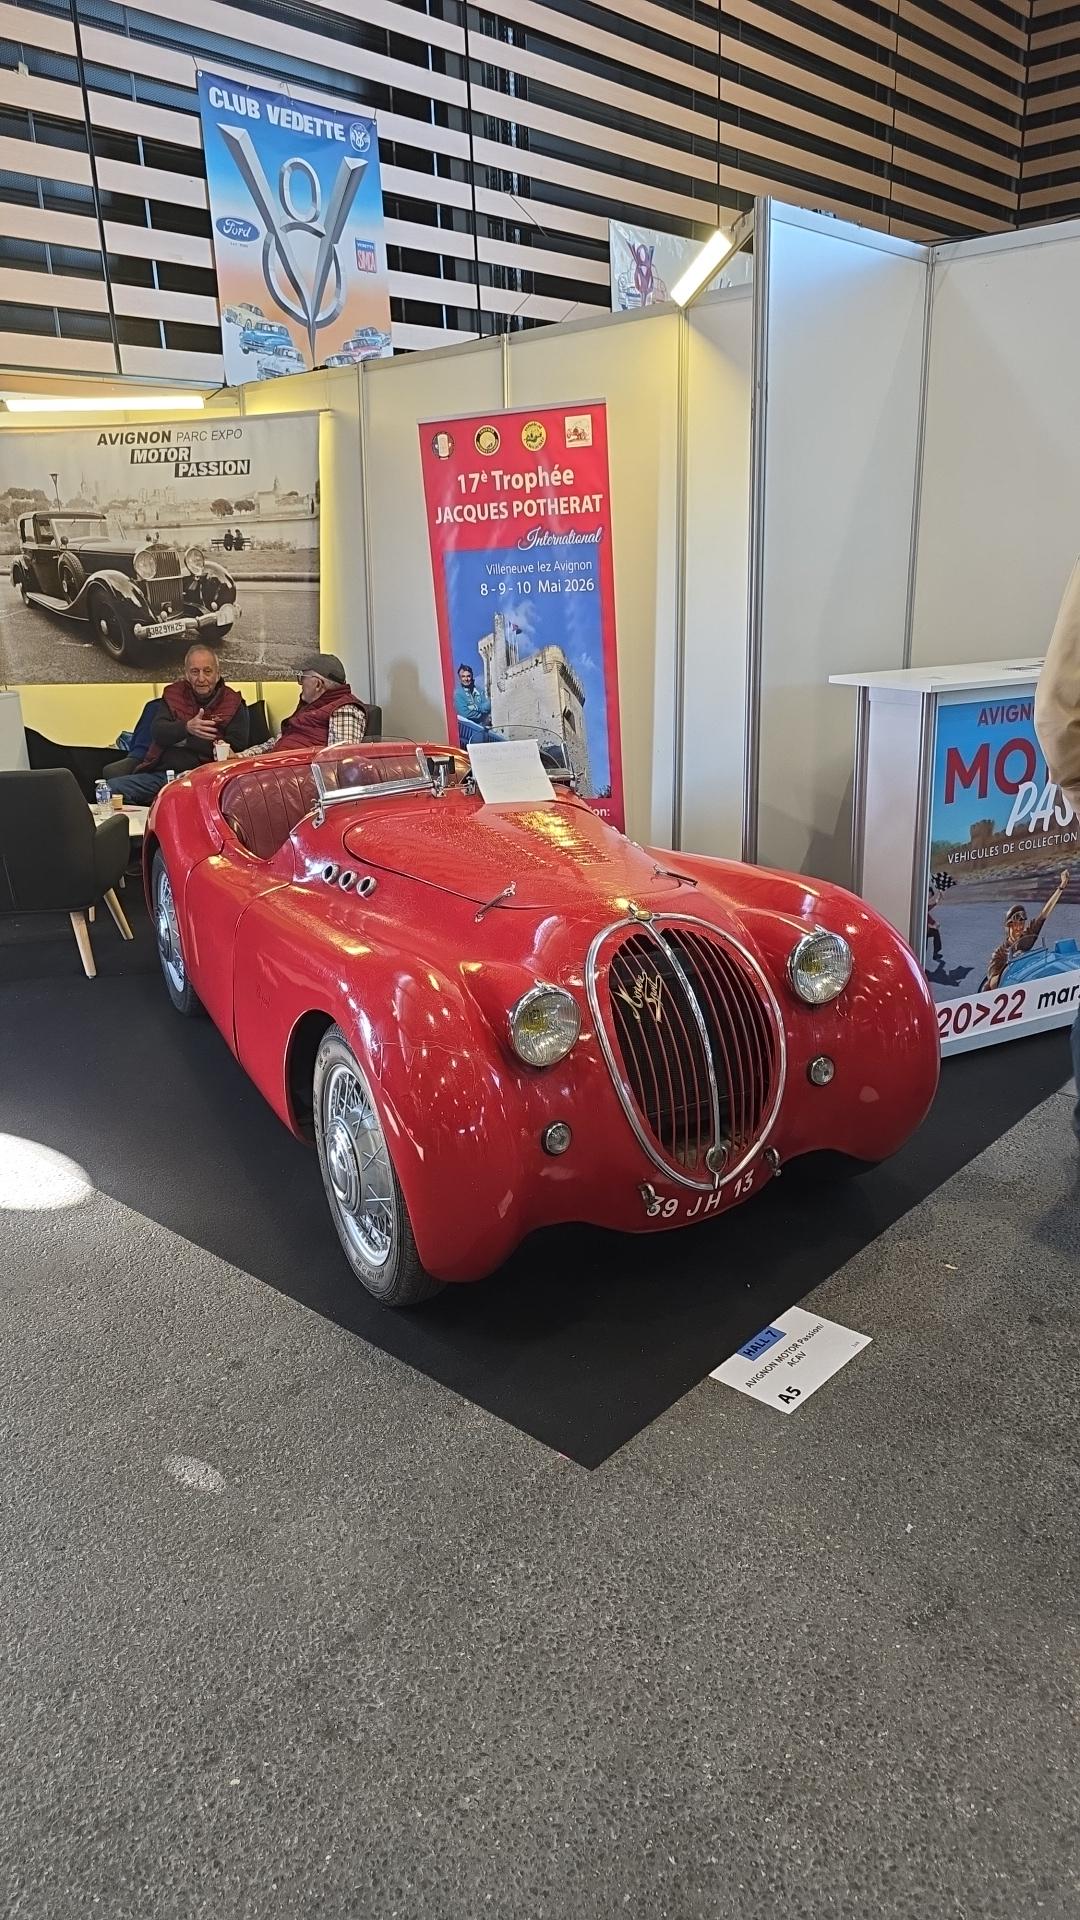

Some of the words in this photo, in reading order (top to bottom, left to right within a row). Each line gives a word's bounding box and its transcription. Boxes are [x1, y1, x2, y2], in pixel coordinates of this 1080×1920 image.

[208, 86, 261, 120] CLUB
[266, 104, 346, 142] VEDETTE
[223, 218, 252, 238] Ford
[97, 430, 172, 446] AVIGNON
[176, 430, 208, 442] PARC
[211, 428, 243, 441] EXPO
[132, 447, 190, 463] MOTOR
[178, 460, 249, 477] PASSION
[491, 464, 574, 494] Trophée
[435, 501, 509, 525] JACQUES
[512, 494, 603, 518] POTHERAT
[517, 526, 603, 551] International
[485, 562, 534, 575] Villeneuve
[537, 561, 552, 572] lez
[553, 560, 593, 574] Avignon
[538, 579, 561, 593] Mai
[564, 578, 595, 592] 2026
[977, 703, 1036, 728] AVIGN
[944, 737, 1050, 805] MO
[947, 844, 1000, 865] VEHICULES
[1002, 842, 1015, 855] DE
[1017, 832, 1079, 852] COLLECTION
[1037, 984, 1080, 1011] mar
[646, 1195, 679, 1218] 39
[733, 1168, 756, 1200] 13
[743, 1335, 770, 1357] HALL
[769, 1330, 778, 1339] 7
[745, 1361, 778, 1389] AVIGNON
[777, 1341, 802, 1364] MOTOR
[786, 1350, 808, 1368] ACAV
[777, 1385, 803, 1405] A5
